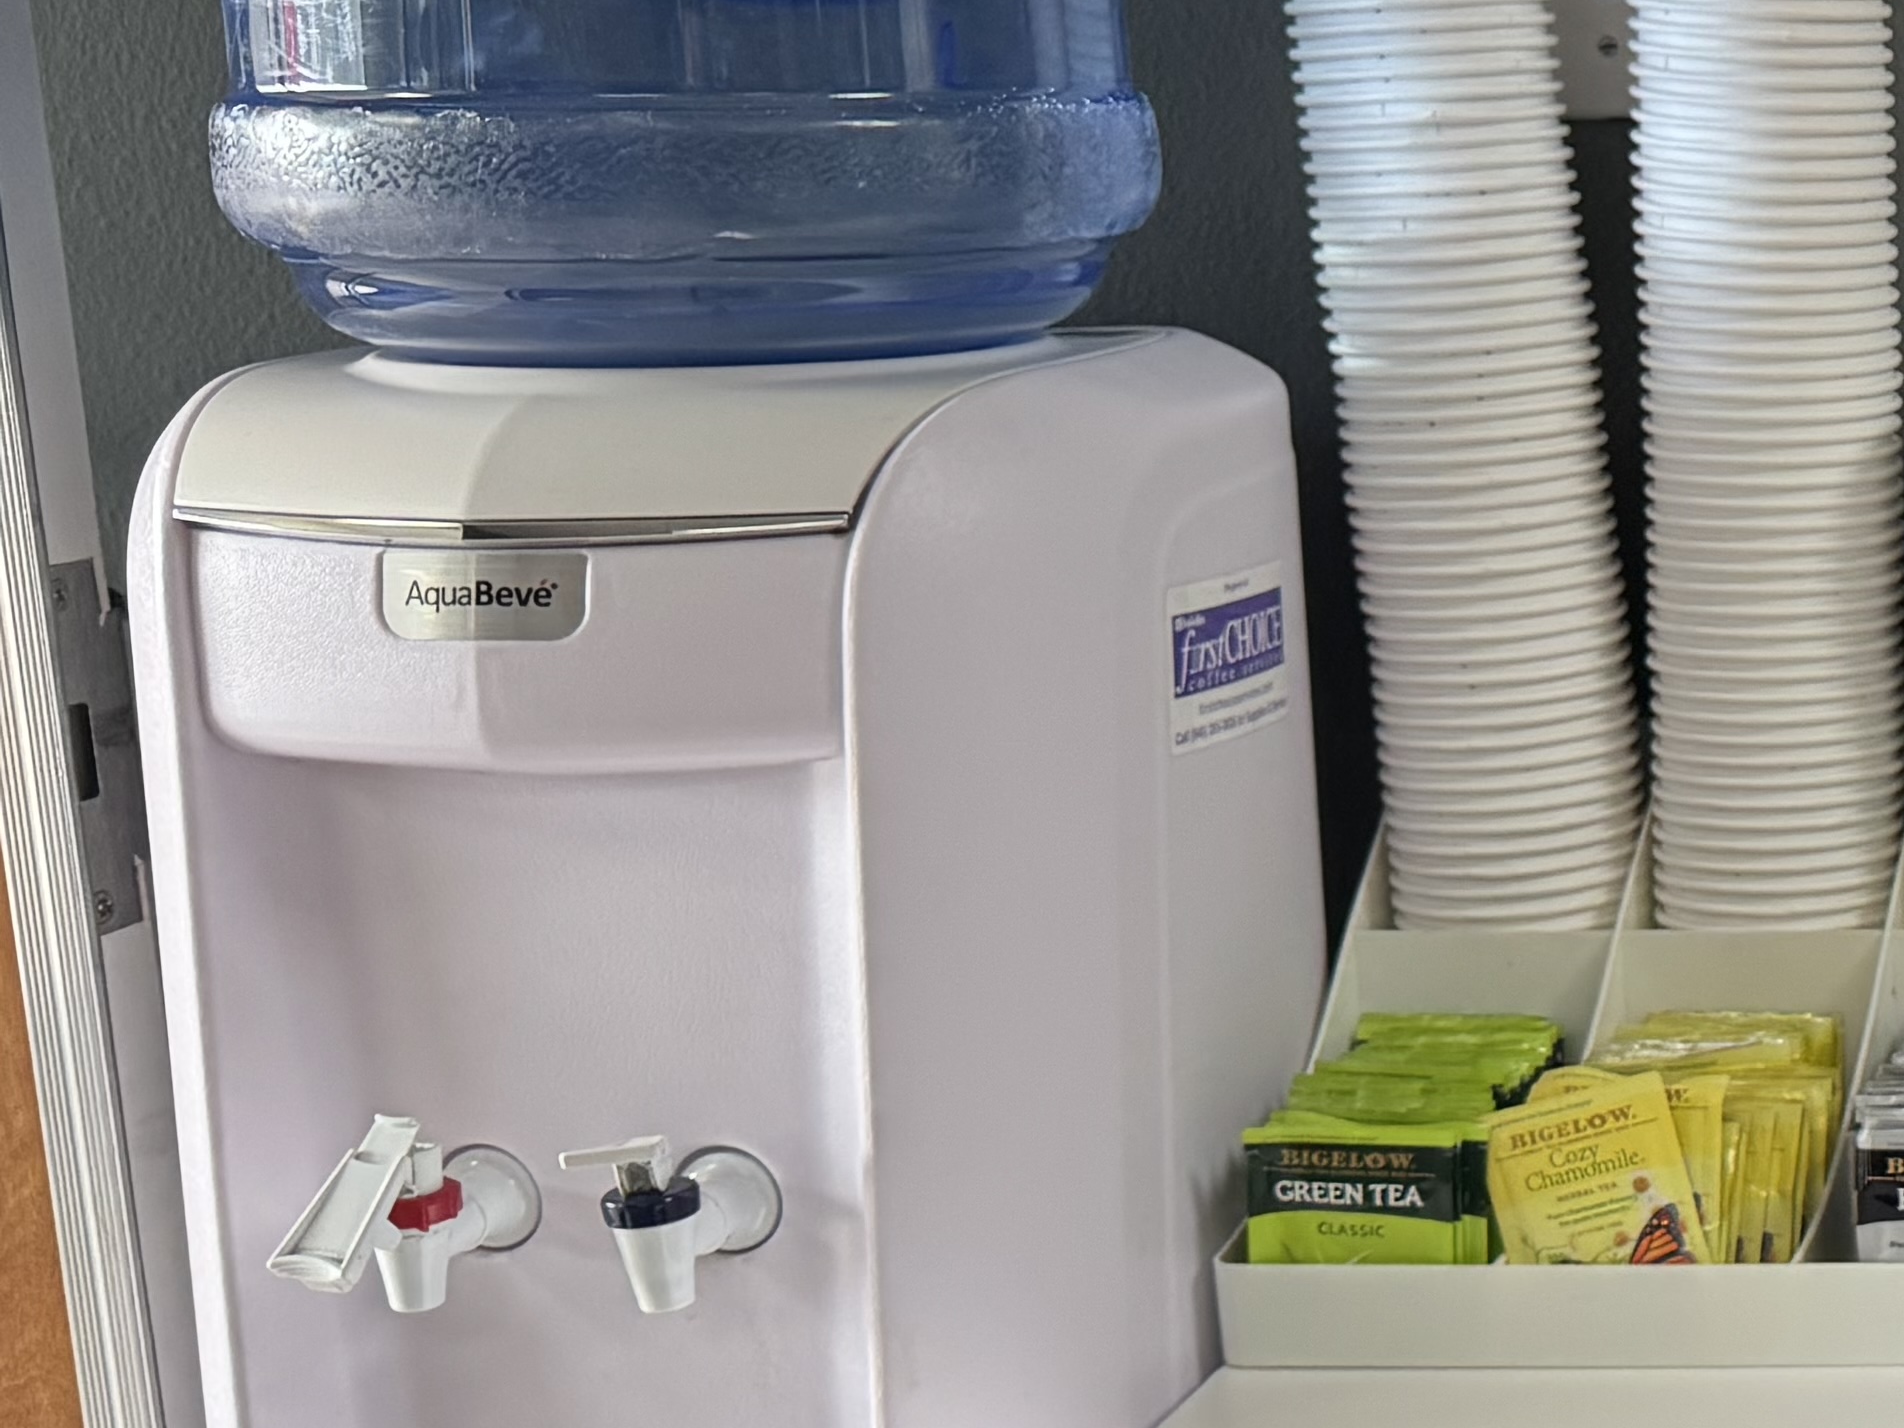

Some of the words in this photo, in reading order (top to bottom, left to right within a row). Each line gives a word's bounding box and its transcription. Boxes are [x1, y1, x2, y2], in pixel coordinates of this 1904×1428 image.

[1549, 1144, 1600, 1169] Cozy
[1524, 1147, 1640, 1193] Chamomile
[1275, 1180, 1364, 1206] GREEN
[1369, 1183, 1425, 1208] TEA
[1317, 1221, 1386, 1238] CLASSIC
